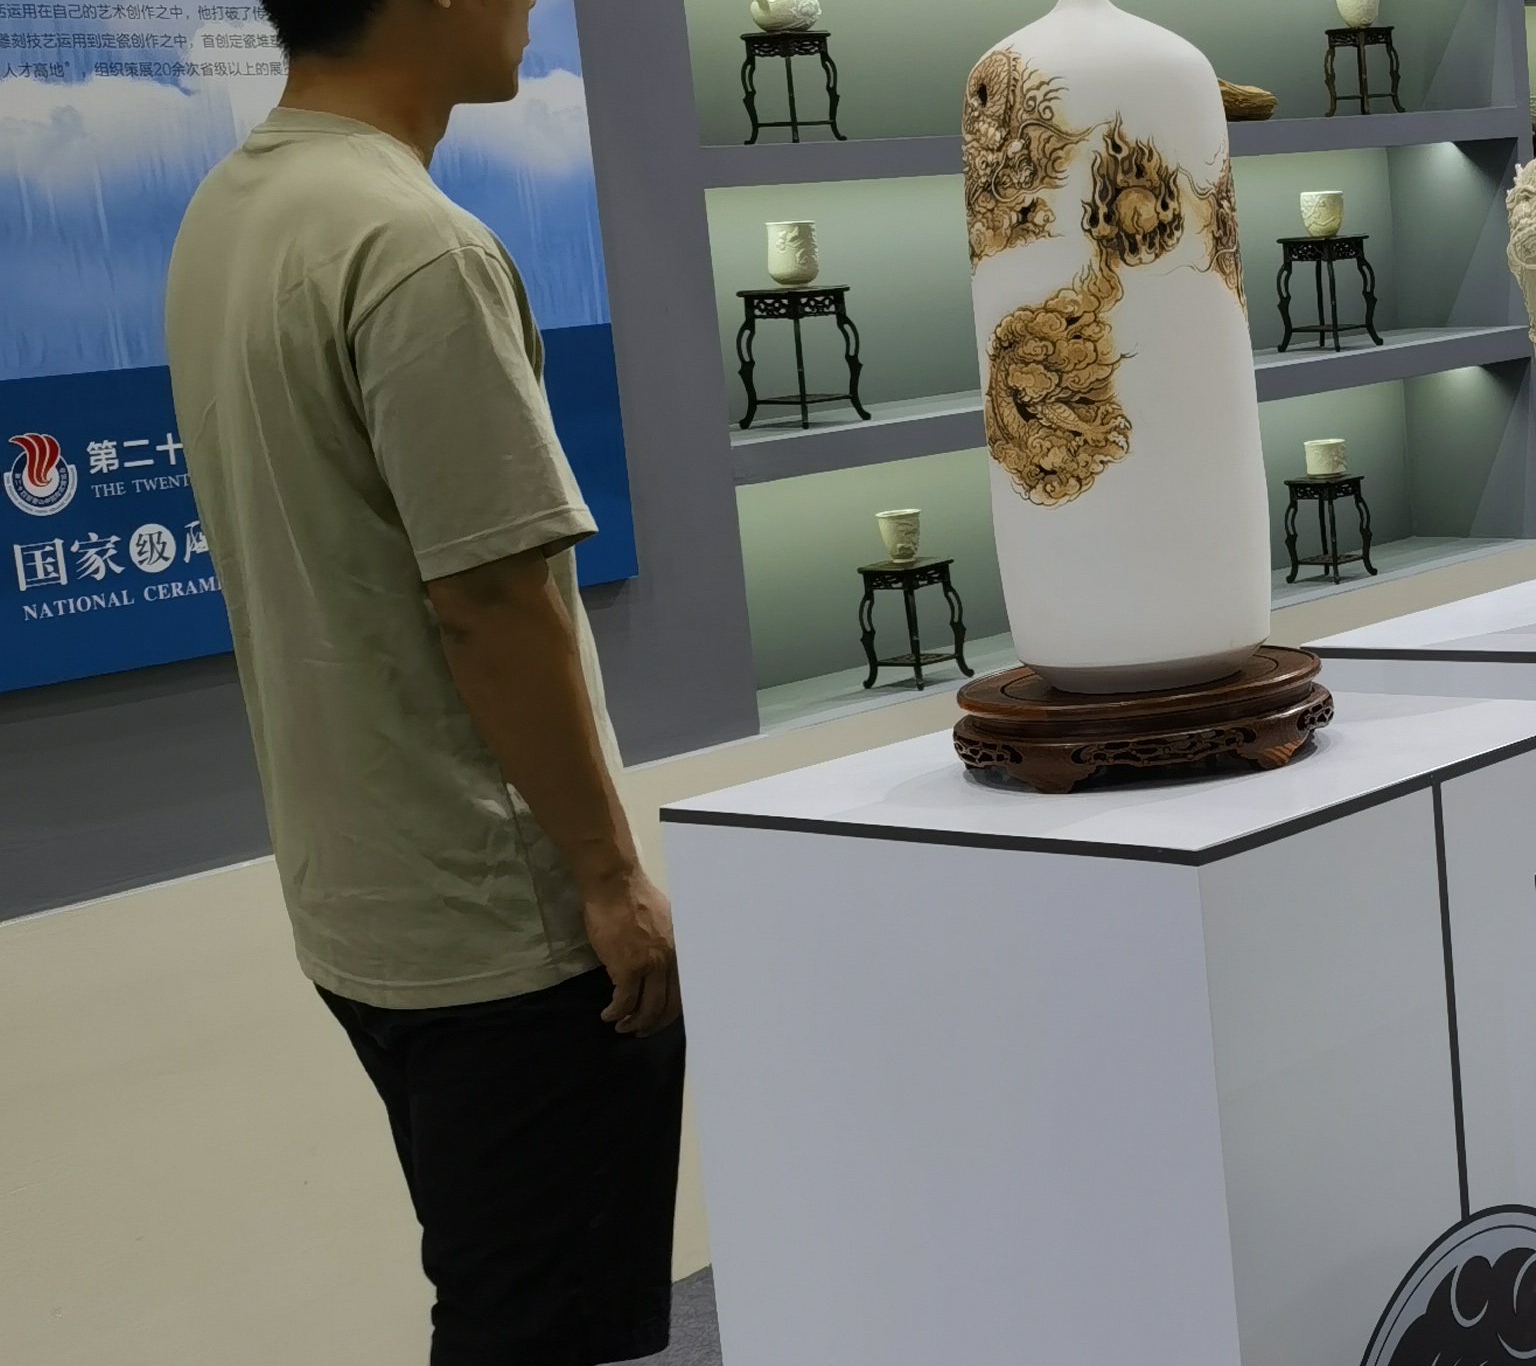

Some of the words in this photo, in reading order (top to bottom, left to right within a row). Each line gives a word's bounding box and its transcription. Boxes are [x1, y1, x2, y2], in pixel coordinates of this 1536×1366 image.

[86, 432, 183, 474] 第二十
[91, 481, 126, 497] THE
[23, 589, 135, 621] NATIONAL
